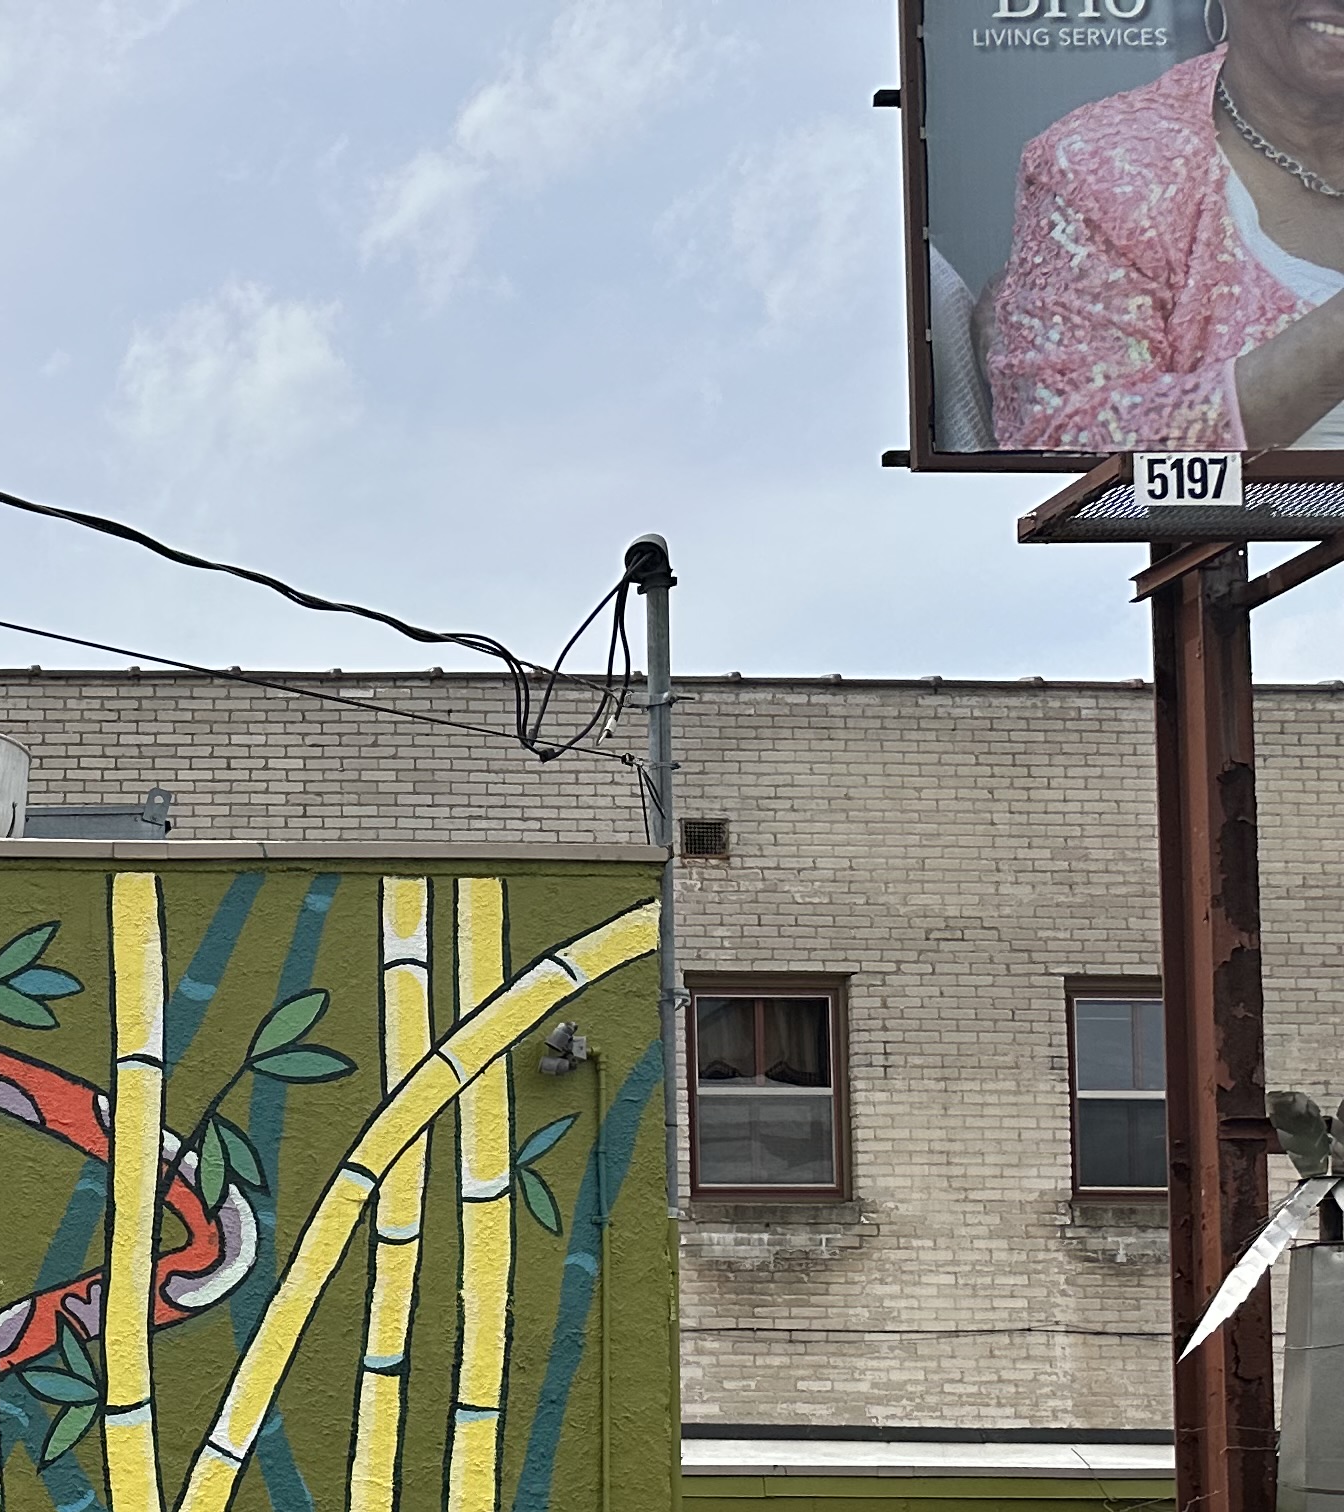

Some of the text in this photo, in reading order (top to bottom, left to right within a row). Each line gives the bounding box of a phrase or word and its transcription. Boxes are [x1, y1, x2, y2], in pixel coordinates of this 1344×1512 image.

[972, 27, 1168, 47] LIVING SERVICES
[1146, 456, 1228, 500] 5197
